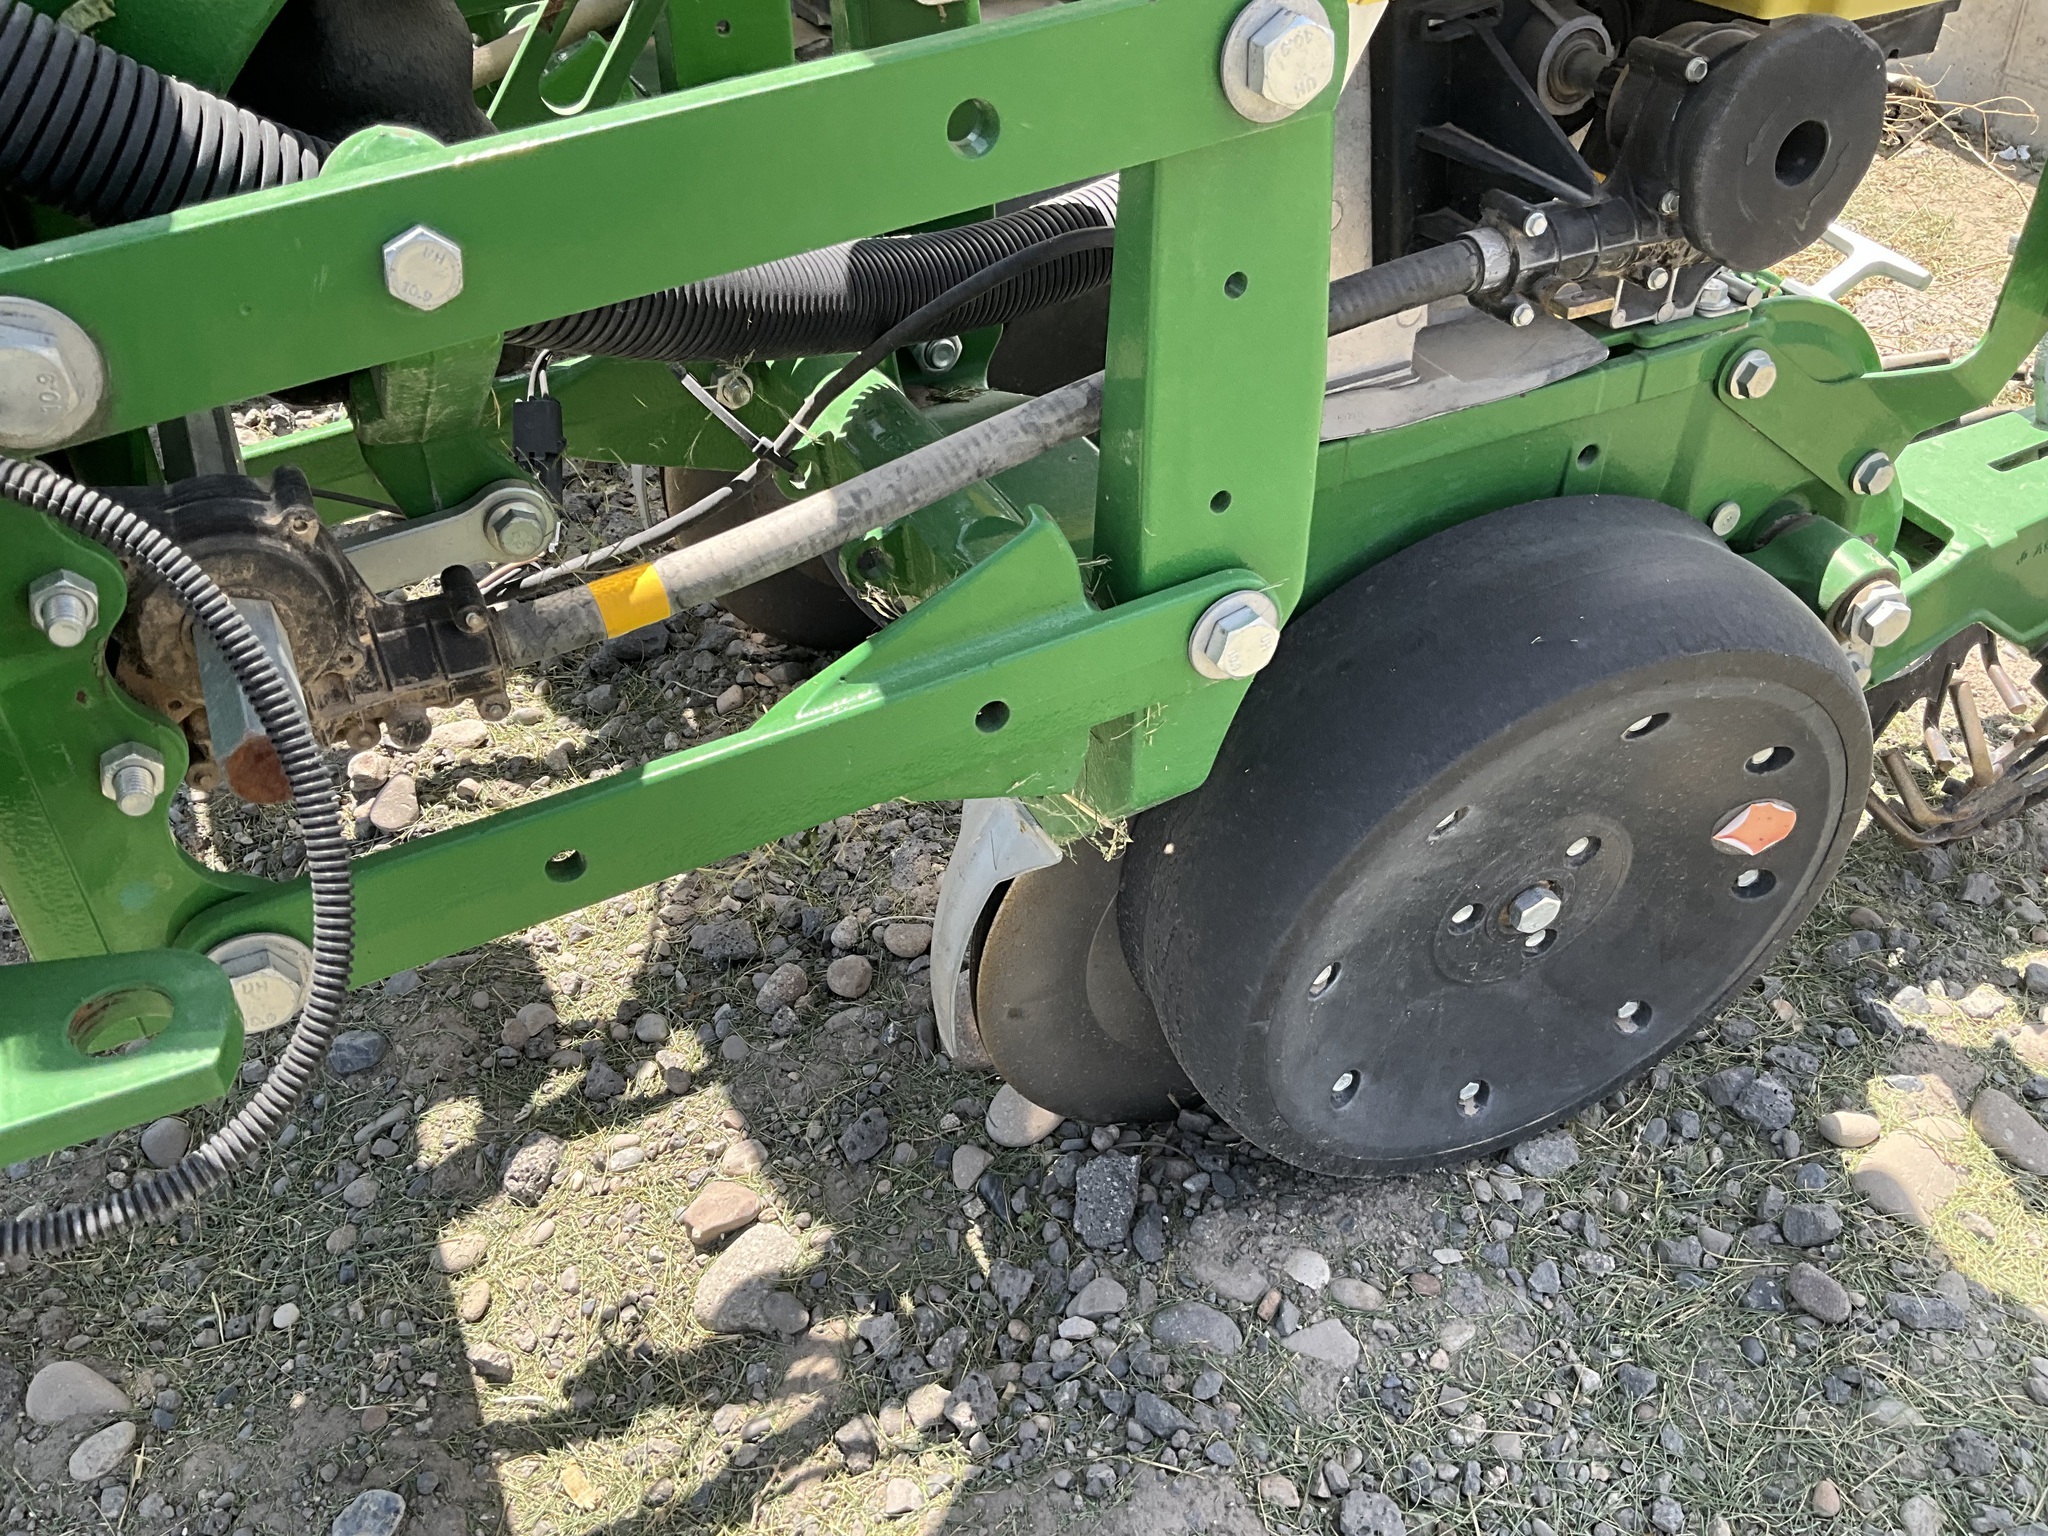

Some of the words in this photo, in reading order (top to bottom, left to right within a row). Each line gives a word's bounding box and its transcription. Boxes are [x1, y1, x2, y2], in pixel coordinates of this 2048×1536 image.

[423, 245, 446, 266] UH
[401, 280, 434, 302] 10.9
[36, 373, 62, 415] 10.9
[241, 980, 268, 996] UH
